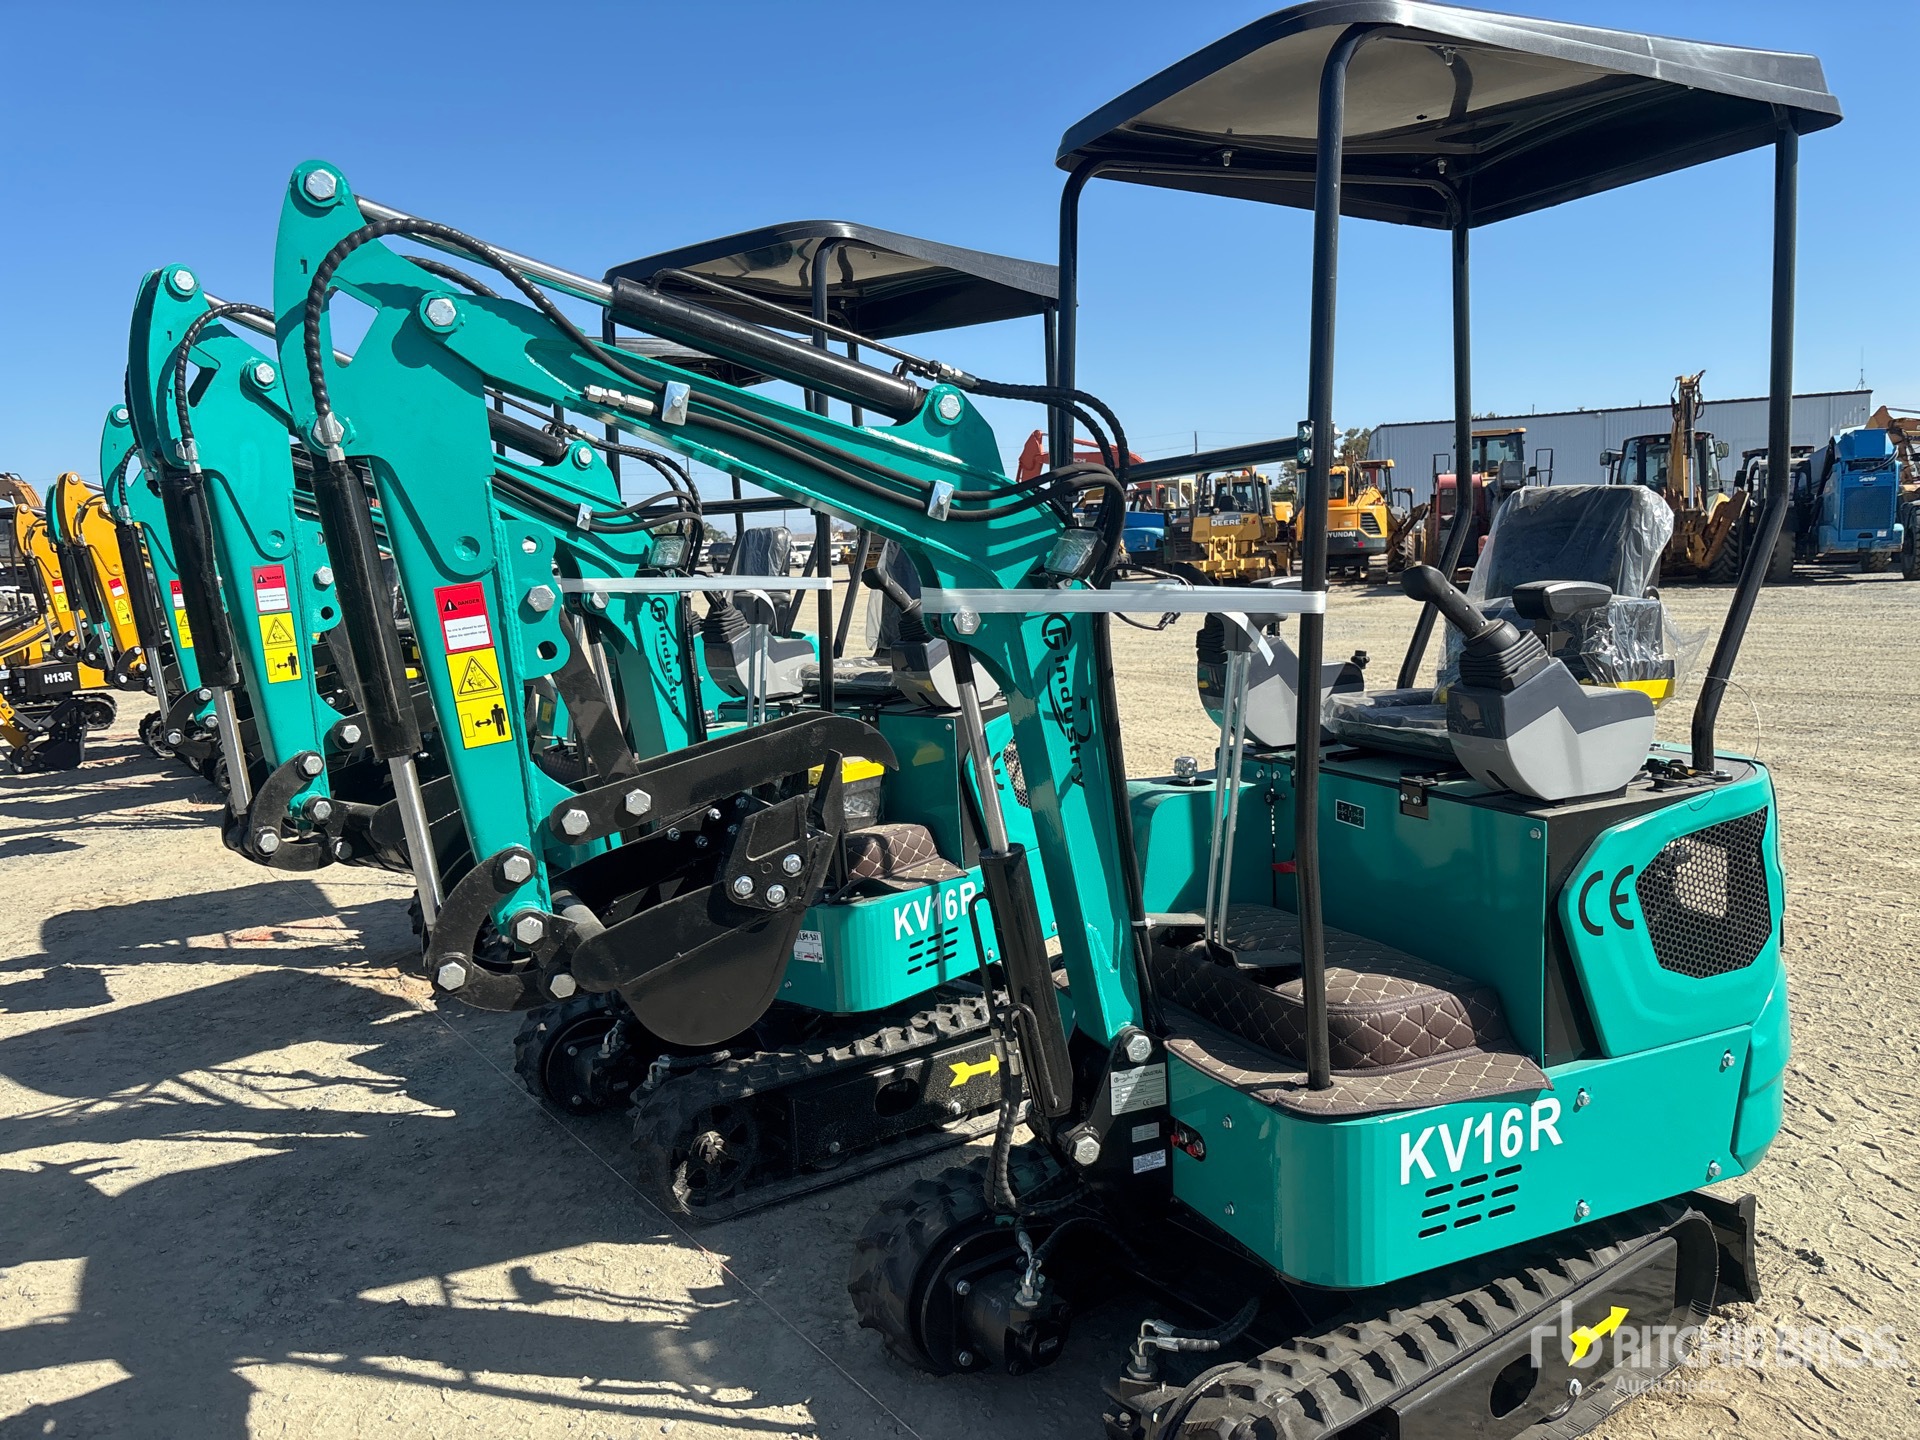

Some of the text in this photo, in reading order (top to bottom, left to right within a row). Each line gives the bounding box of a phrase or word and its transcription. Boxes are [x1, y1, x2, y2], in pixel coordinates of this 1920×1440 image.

[44, 672, 73, 684] H13R
[894, 882, 979, 940] KV16R
[1578, 864, 1634, 936] CE
[1400, 1098, 1563, 1186] KV16R
